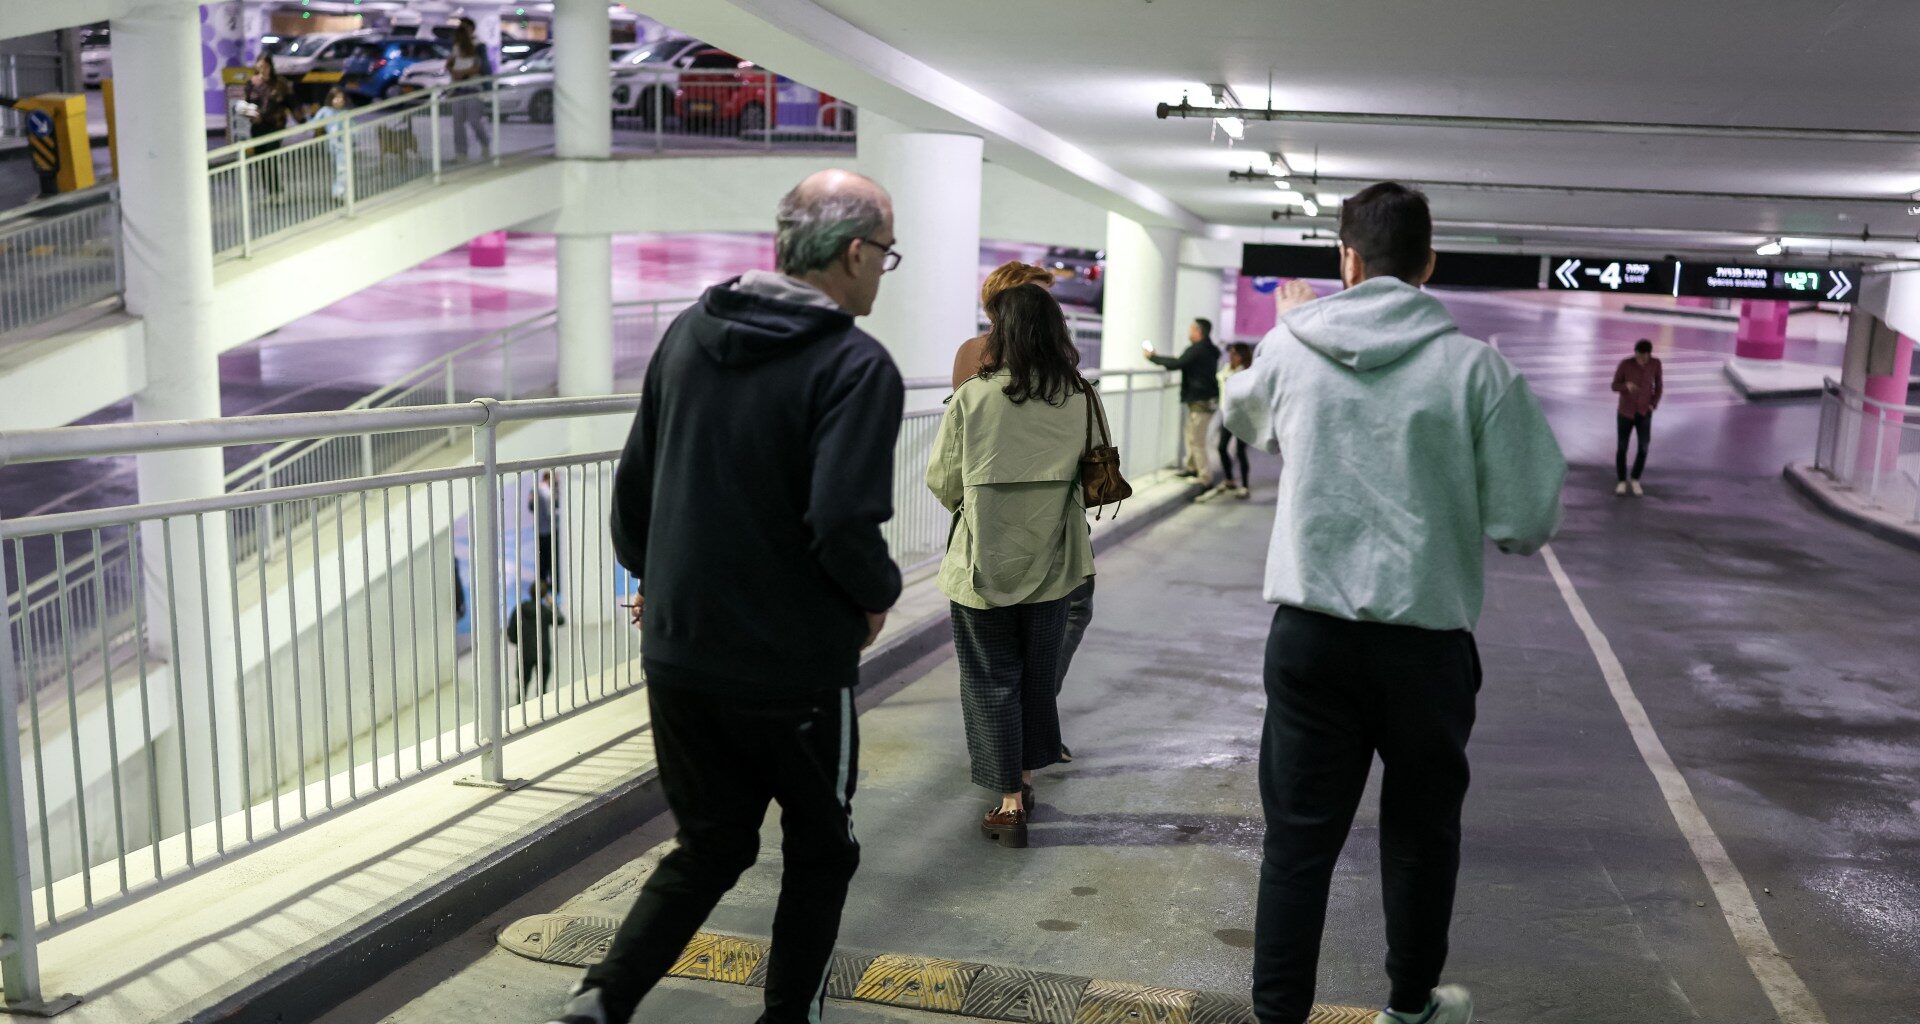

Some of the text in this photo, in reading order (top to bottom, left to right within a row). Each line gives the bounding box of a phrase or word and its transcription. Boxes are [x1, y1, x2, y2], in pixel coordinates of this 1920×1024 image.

[1585, 262, 1622, 289] -4
[1624, 274, 1645, 283] Level
[1784, 272, 1818, 290] 427
